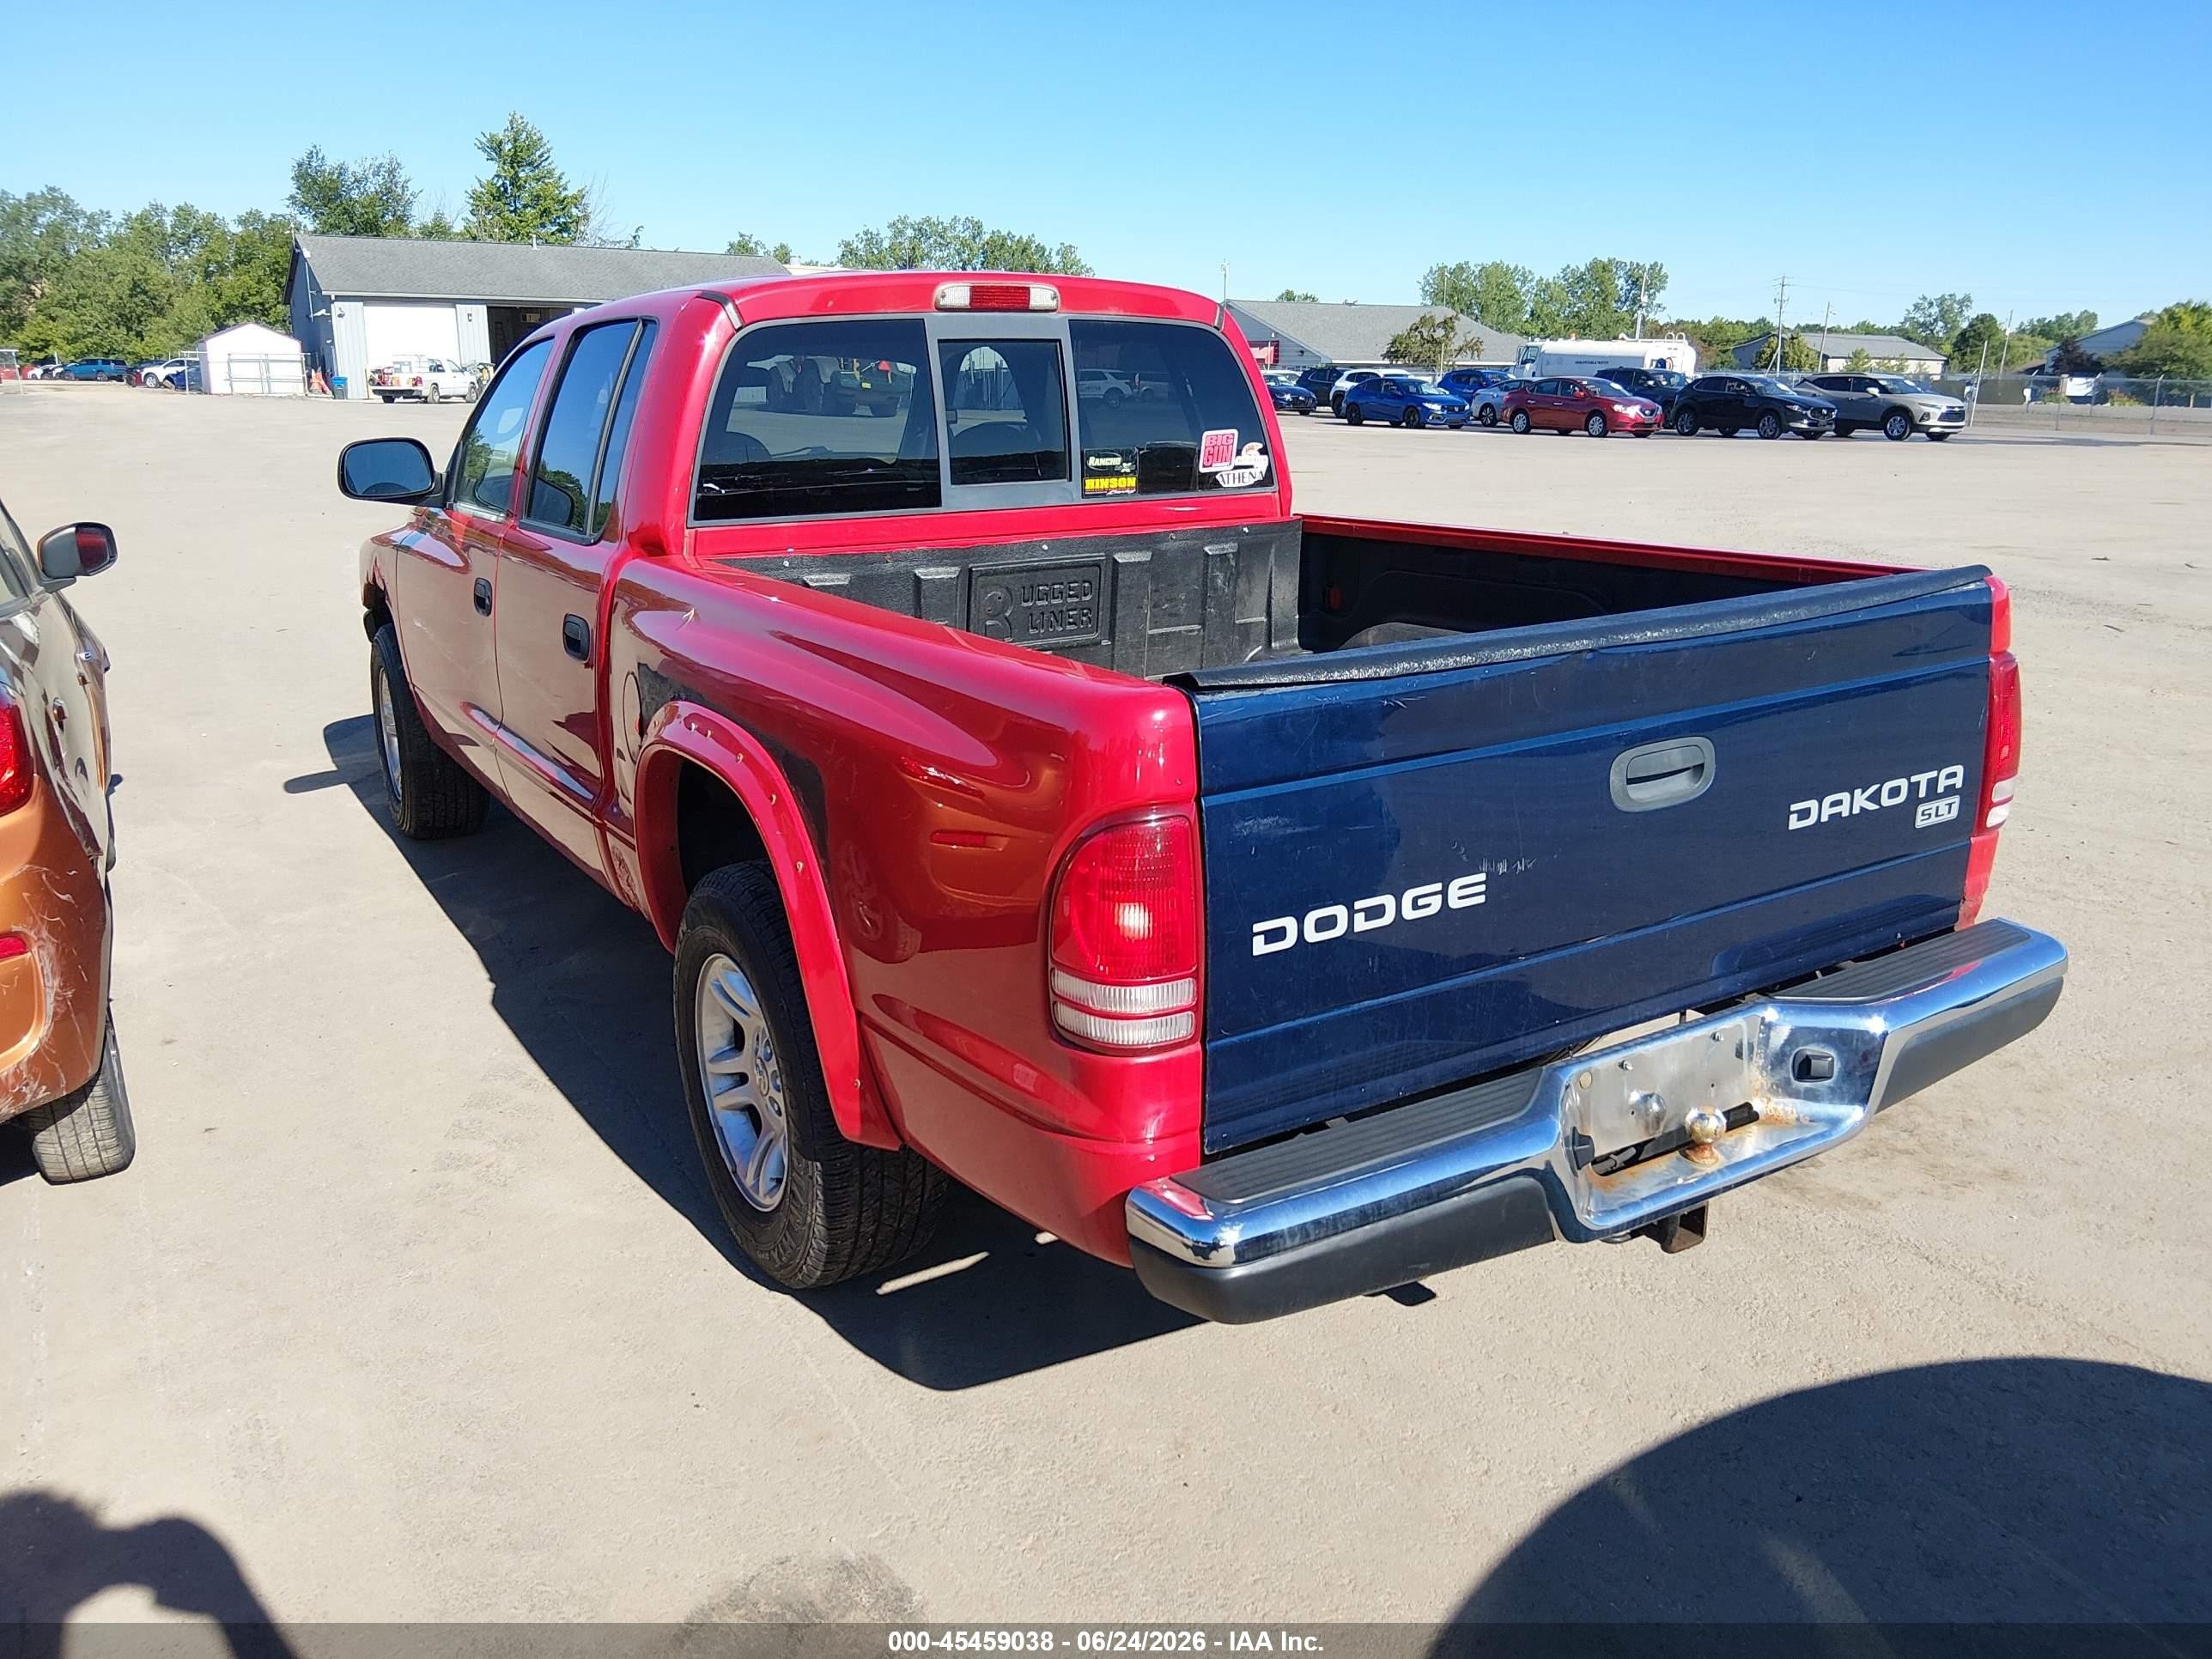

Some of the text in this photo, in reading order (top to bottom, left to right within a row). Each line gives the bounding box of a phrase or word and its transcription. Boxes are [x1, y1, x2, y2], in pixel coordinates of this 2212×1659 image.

[1205, 433, 1234, 447] BIG
[1203, 445, 1233, 466] GUN
[1085, 477, 1136, 489] HINSON
[1218, 470, 1265, 486] ATHENA
[1030, 608, 1093, 634] LINER
[1788, 764, 1965, 830] DAKOTA
[1919, 800, 1957, 823] SLT
[1252, 872, 1487, 957] DODGE
